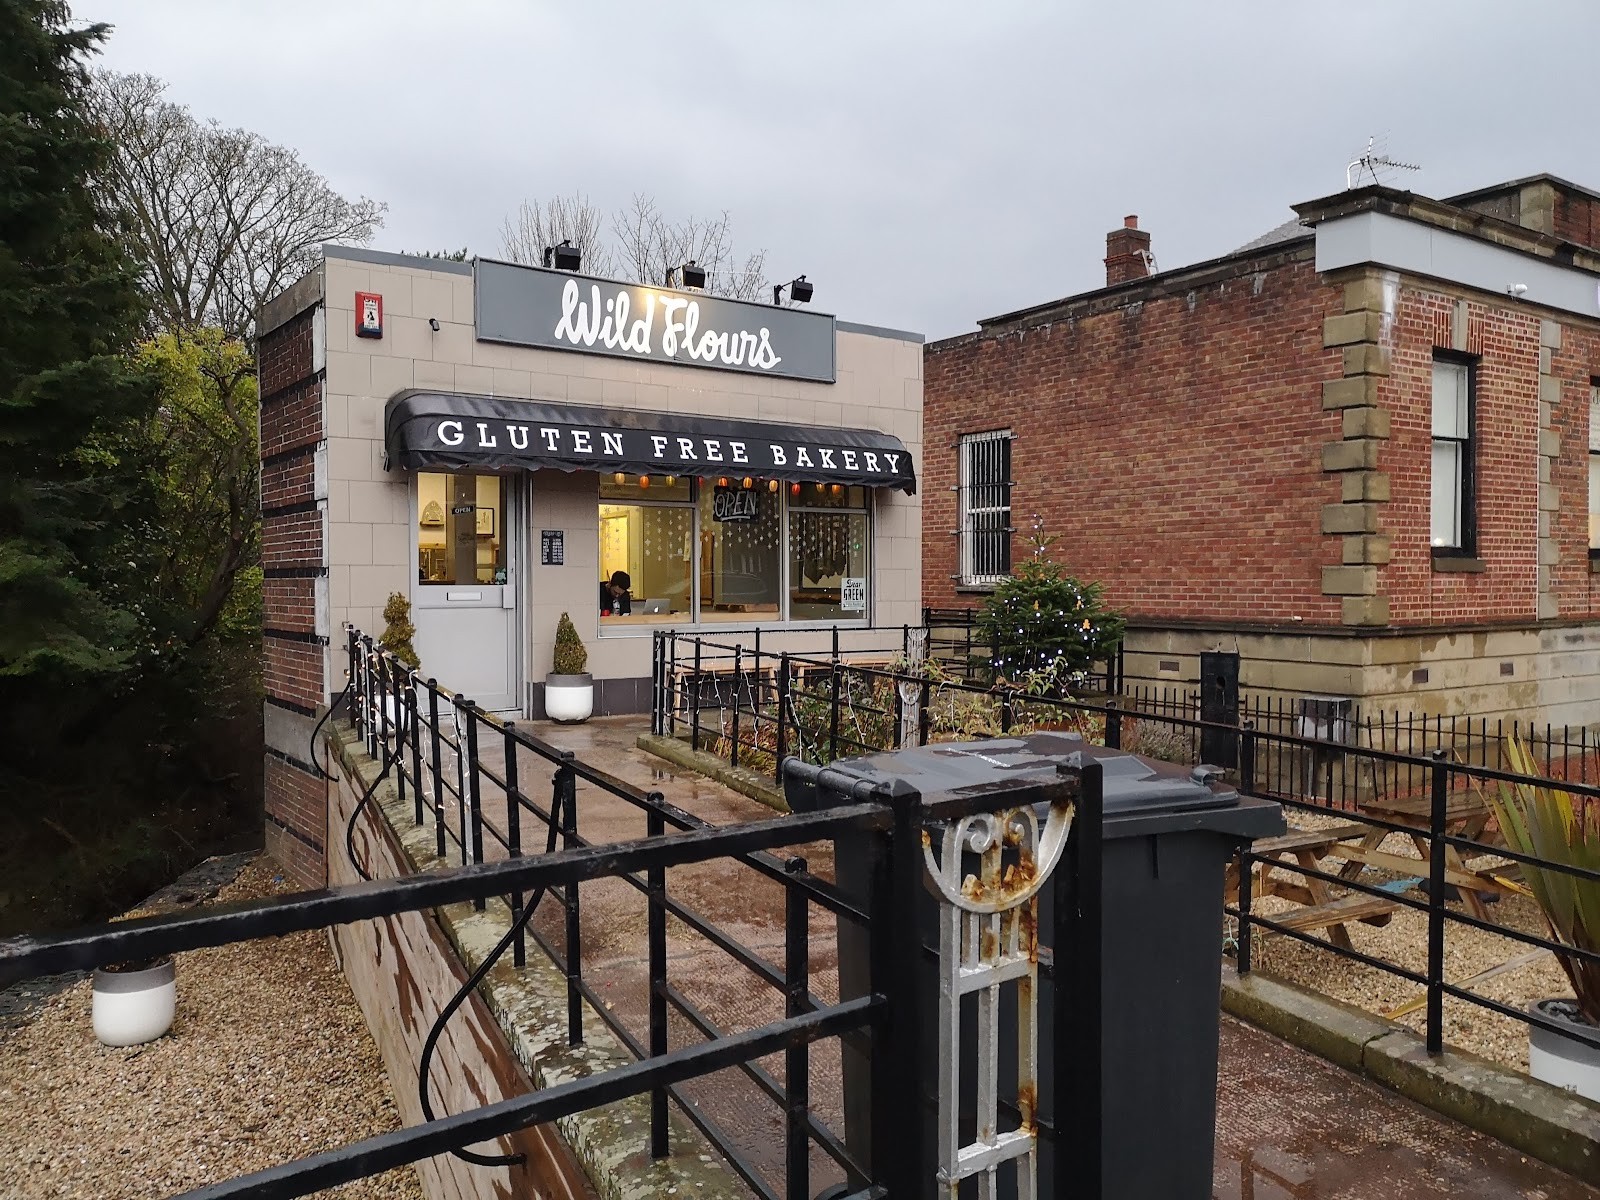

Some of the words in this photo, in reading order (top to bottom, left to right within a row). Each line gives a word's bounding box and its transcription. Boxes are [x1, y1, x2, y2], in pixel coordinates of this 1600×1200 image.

[554, 278, 653, 355] Wild
[658, 295, 782, 370] Flours
[436, 420, 625, 457] GLUTEN
[650, 435, 750, 464] FREE
[769, 444, 901, 475] BAKERY
[454, 506, 471, 514] OPEN
[714, 490, 757, 518] OPEN
[846, 578, 862, 588] Dear
[843, 588, 864, 601] GREEN
